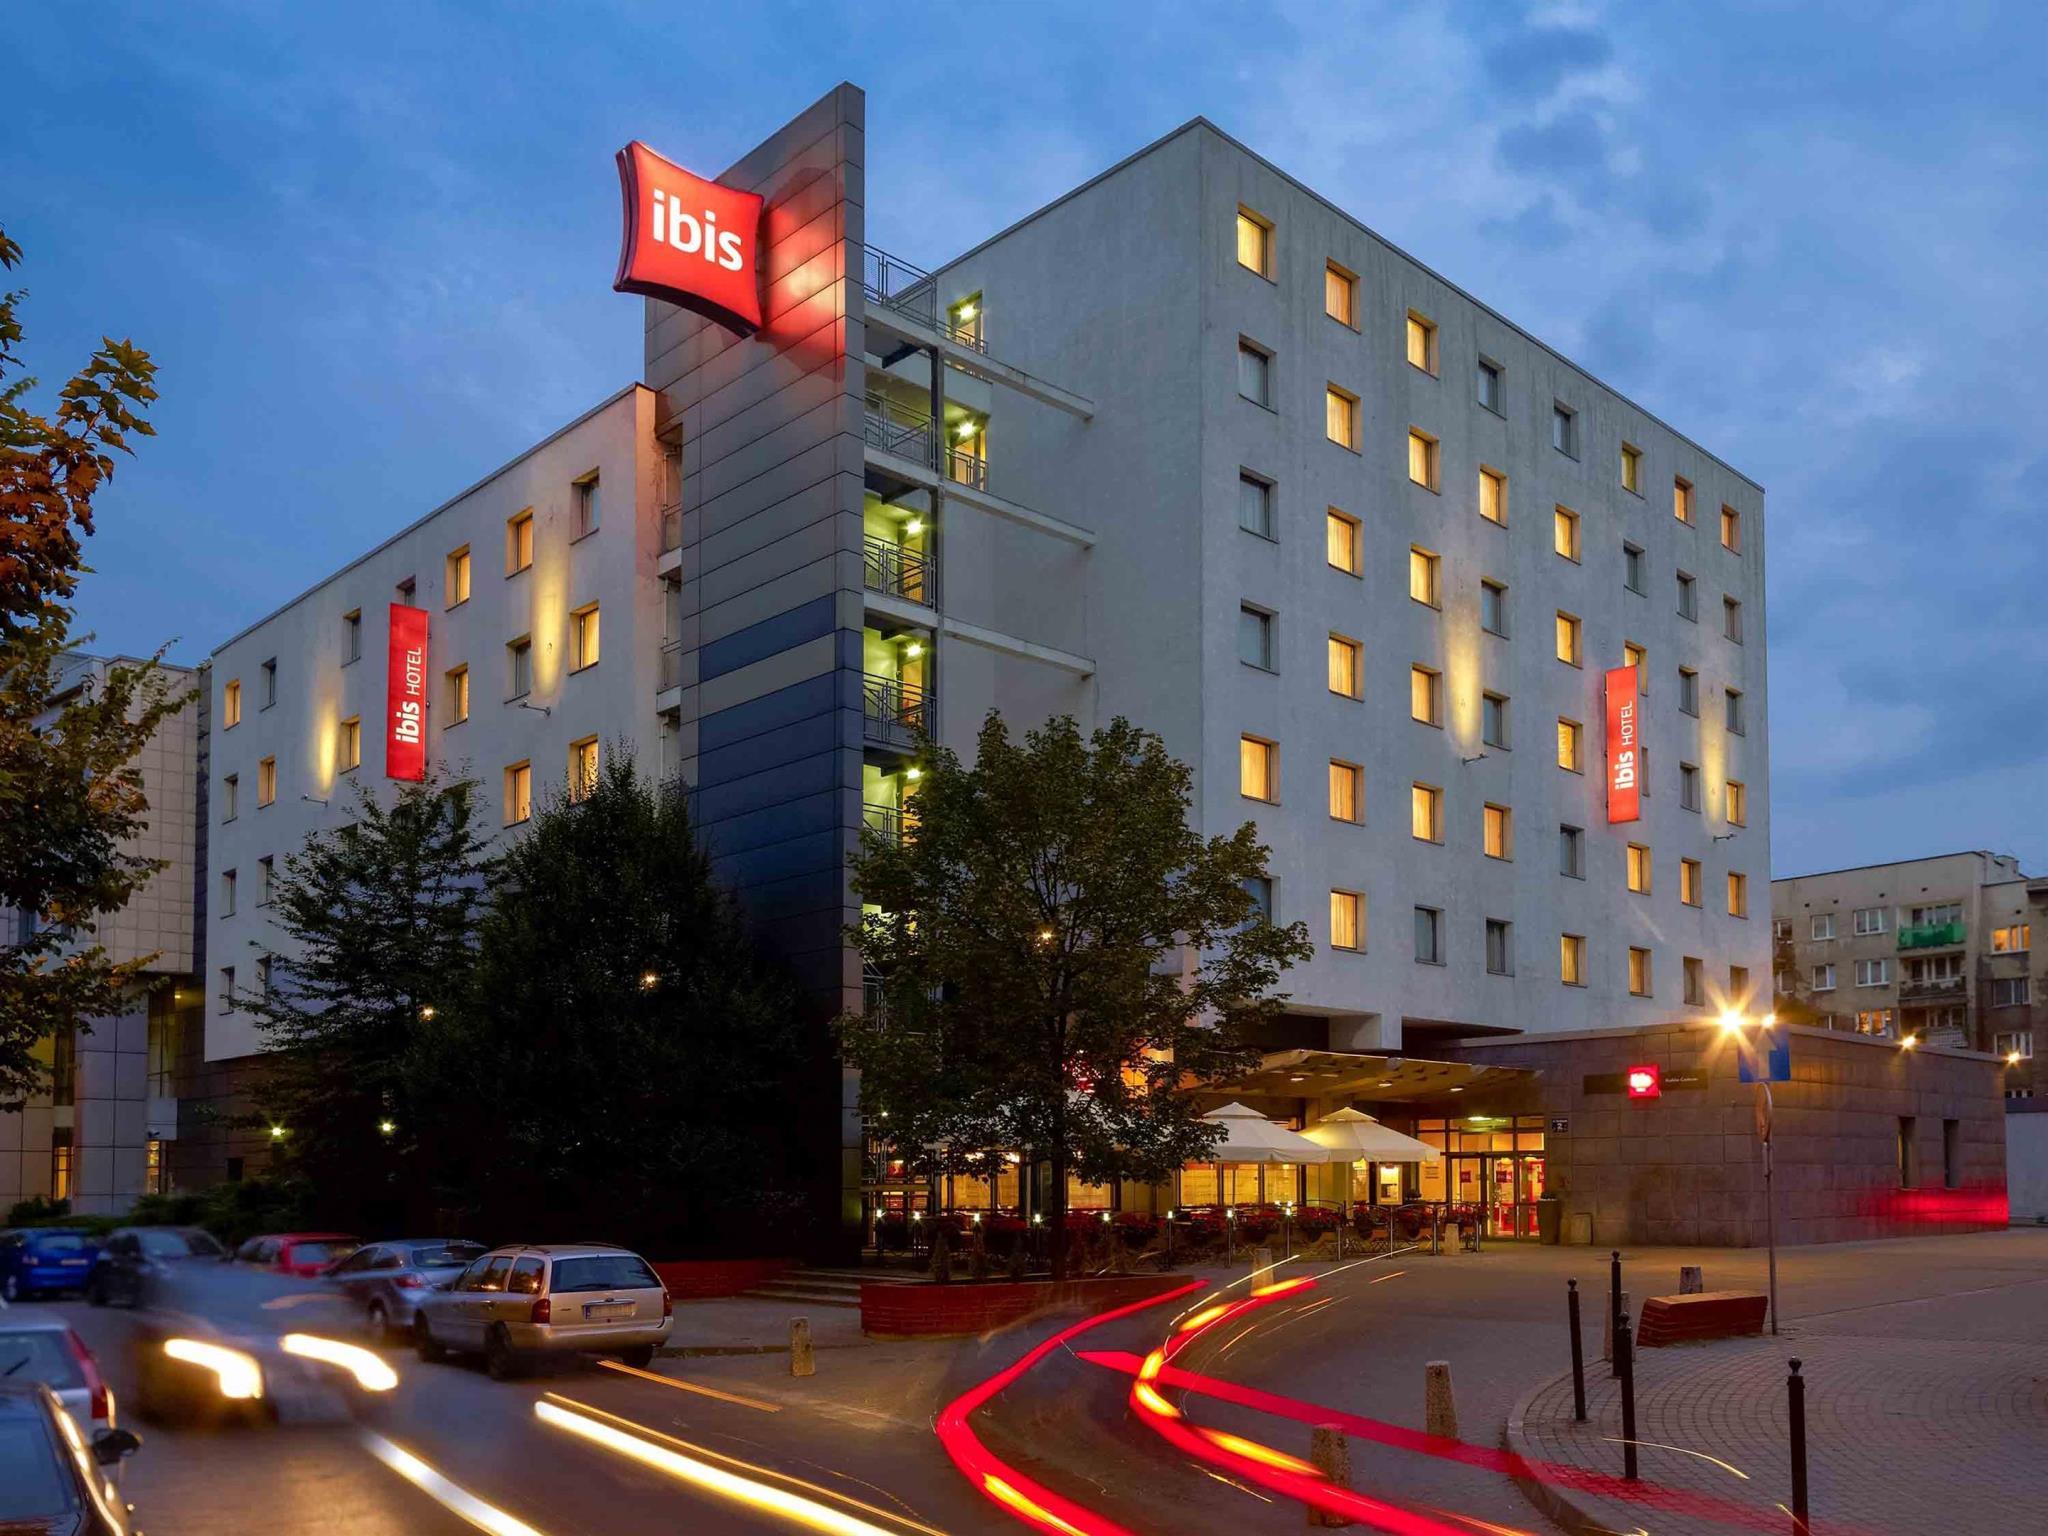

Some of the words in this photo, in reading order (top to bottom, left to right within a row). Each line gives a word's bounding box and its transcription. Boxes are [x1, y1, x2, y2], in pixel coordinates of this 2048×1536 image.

[653, 188, 744, 272] ibis
[406, 647, 422, 696] HOTEL
[395, 701, 420, 744] ibis
[1621, 700, 1633, 746] HOTEL
[1615, 751, 1634, 790] ibis
